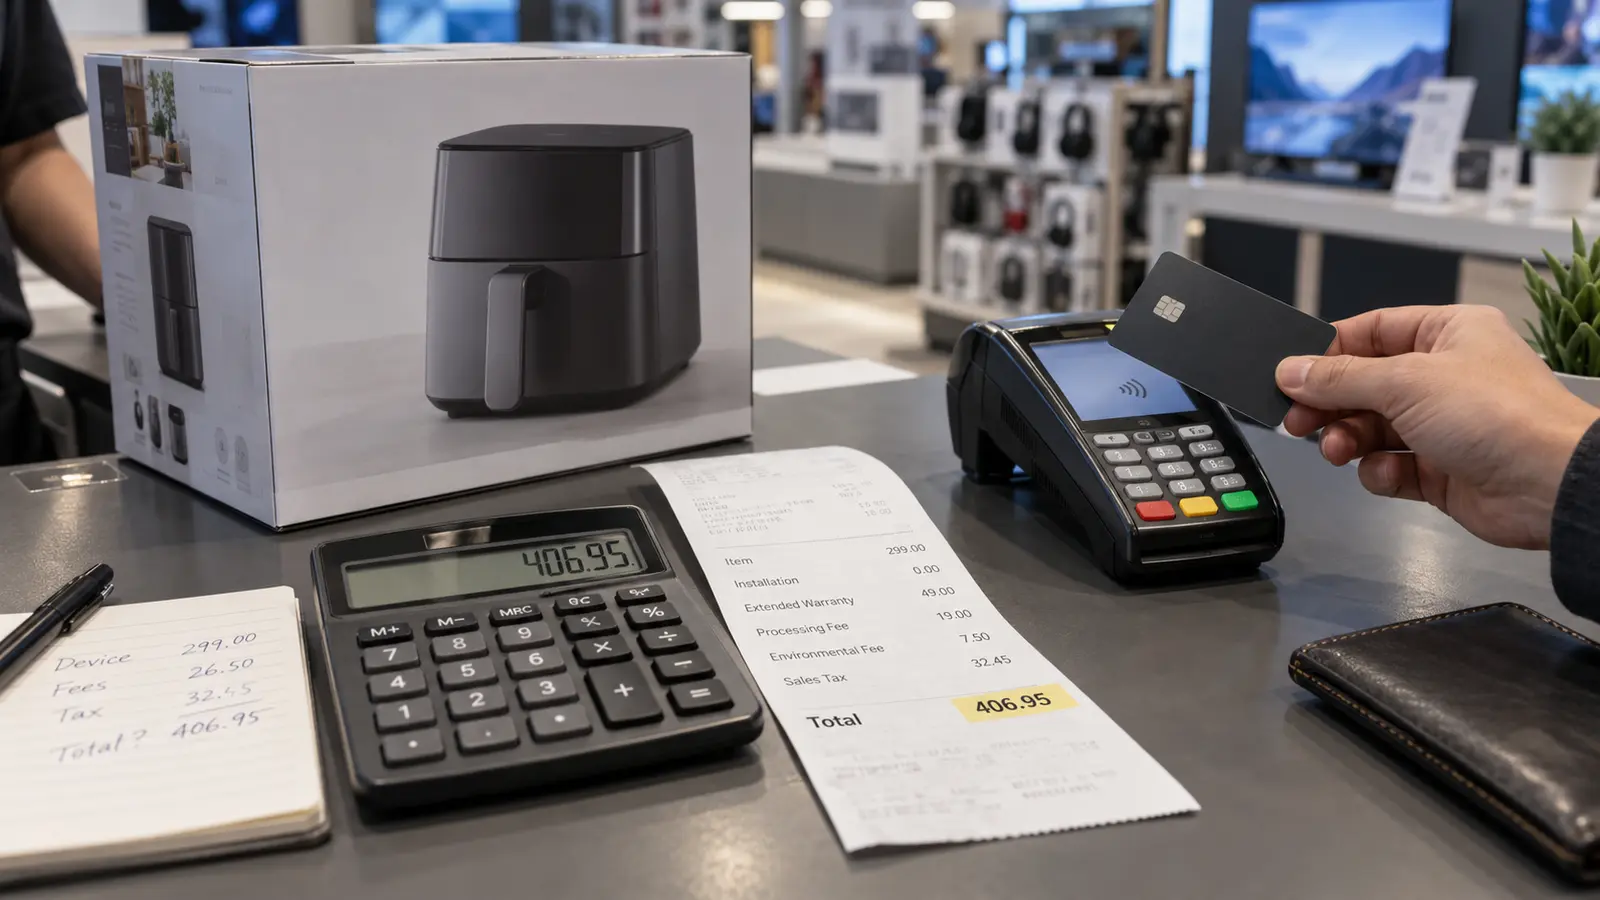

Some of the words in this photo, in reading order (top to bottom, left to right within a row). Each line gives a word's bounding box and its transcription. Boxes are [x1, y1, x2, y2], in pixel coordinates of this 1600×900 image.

[725, 556, 753, 567] Item
[886, 543, 926, 555] 299.00
[734, 575, 799, 589] Installation
[912, 564, 940, 575] 0.00
[744, 598, 801, 613] Extended
[802, 596, 855, 610] Warranty
[921, 586, 956, 598] 49.00
[499, 604, 532, 617] MRC
[370, 625, 400, 638] M+
[756, 622, 826, 637] Processing
[826, 621, 849, 633] Fee
[936, 609, 972, 621] 19.00
[518, 627, 532, 640] 9
[55, 654, 131, 672] Device
[181, 632, 257, 656] 299.00
[453, 637, 467, 650] 8
[769, 647, 859, 662] Environmental
[860, 644, 885, 656] Fee
[959, 632, 991, 644] 7.50
[382, 648, 398, 661] 7
[528, 653, 544, 666] 6
[52, 680, 107, 697] Fees
[188, 658, 254, 680] 26.50
[461, 663, 476, 677] 5
[783, 673, 821, 687] Sales
[822, 673, 848, 684] Tax
[970, 655, 1012, 668] 32.45
[389, 675, 407, 689] 4
[541, 680, 556, 695] 3
[52, 706, 104, 722] Tax
[185, 681, 255, 706] 32.45
[470, 692, 486, 707] 2
[398, 705, 410, 719] 1
[806, 713, 862, 729] Total
[975, 692, 1052, 715] 406.95
[49, 733, 123, 762] Total
[172, 710, 264, 738] 406.95
